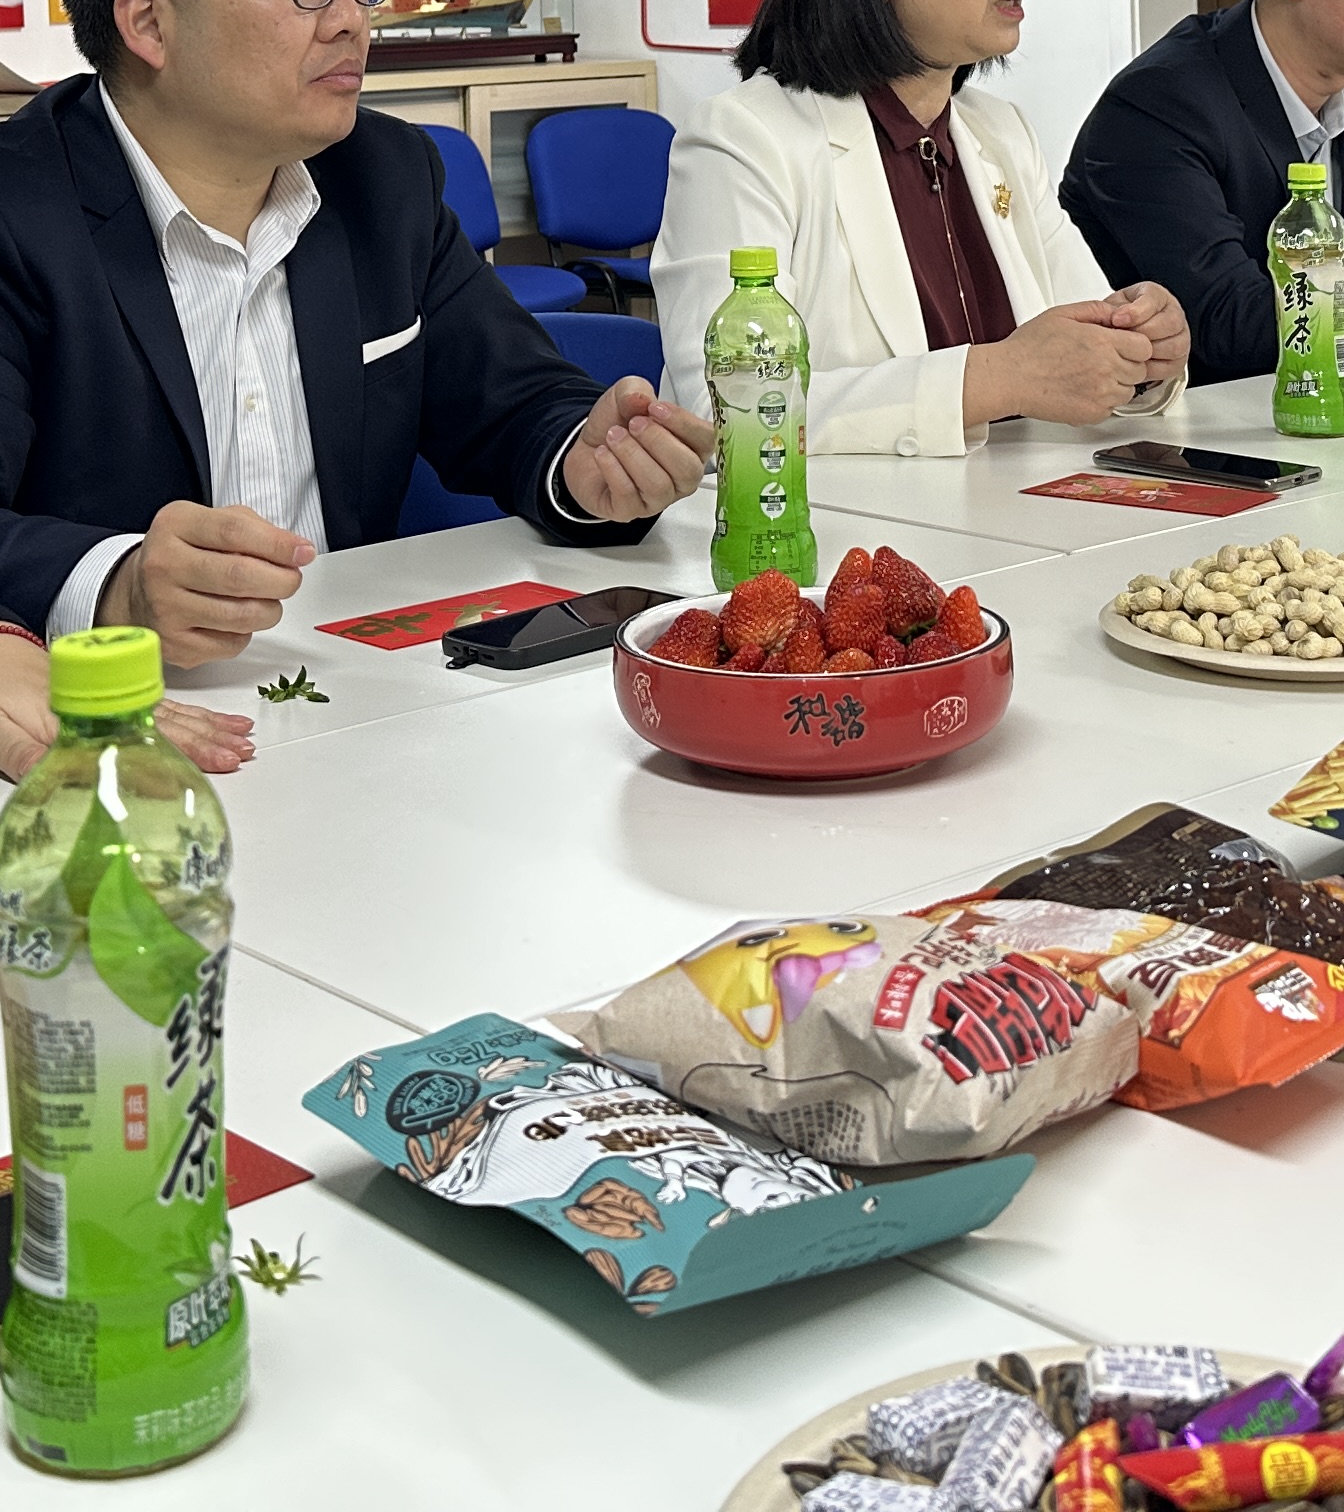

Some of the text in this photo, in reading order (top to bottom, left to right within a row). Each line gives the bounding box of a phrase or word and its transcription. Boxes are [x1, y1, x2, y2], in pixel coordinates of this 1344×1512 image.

[1283, 272, 1314, 356] 绿茶
[757, 360, 788, 379] 绿茶
[125, 1093, 147, 1143] 低糖
